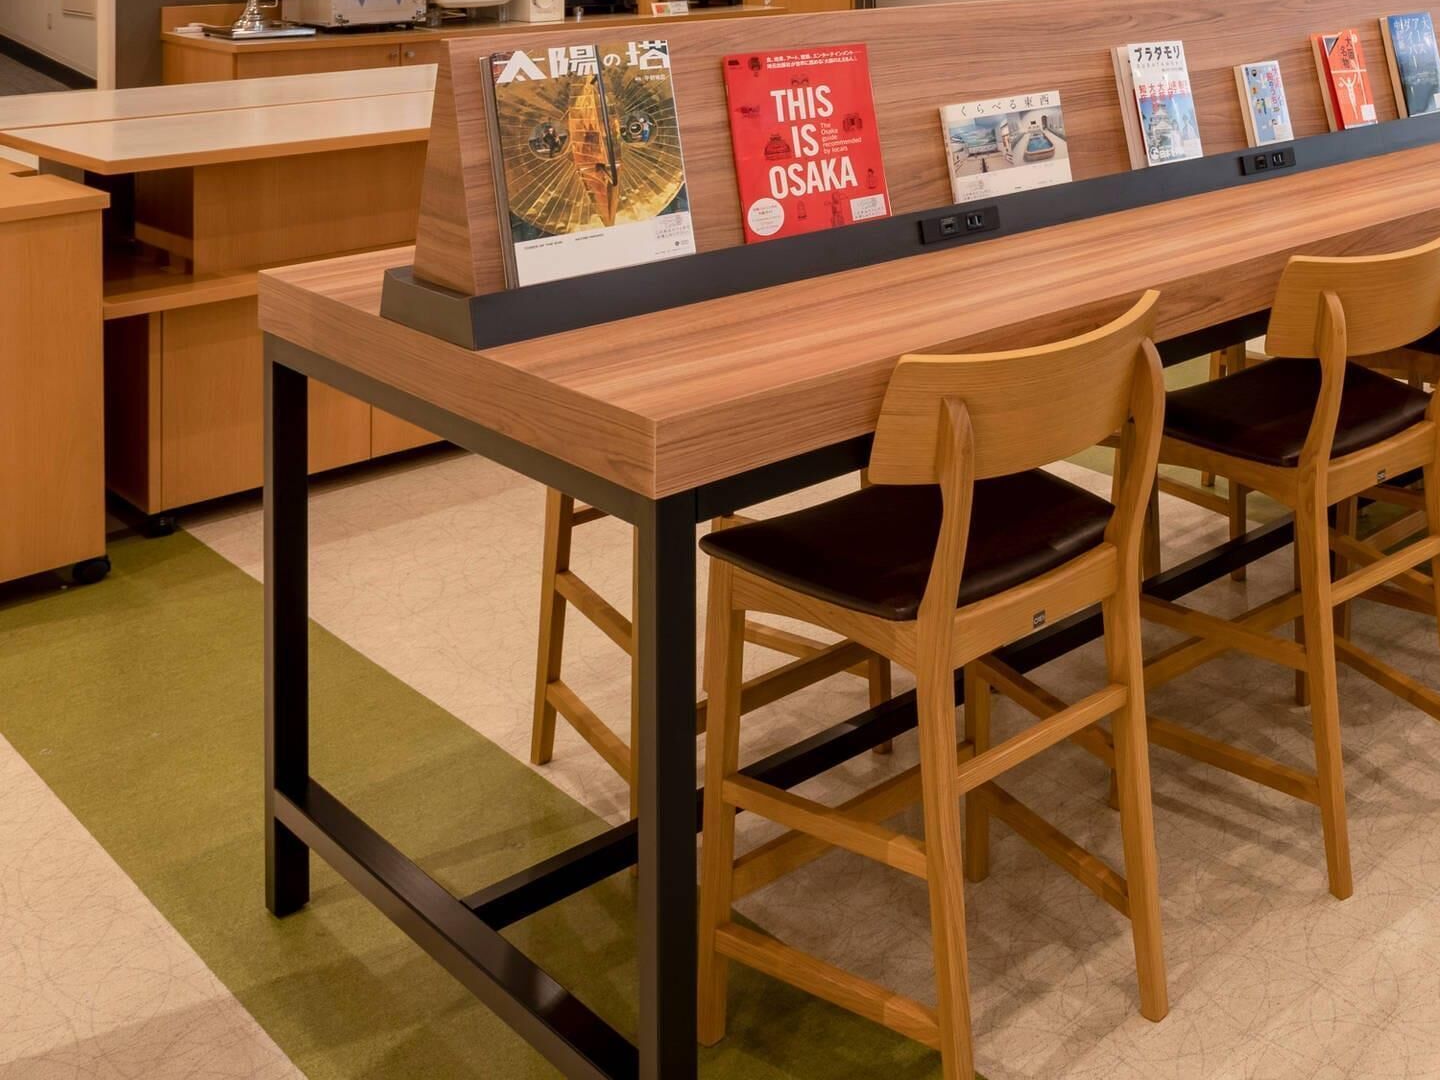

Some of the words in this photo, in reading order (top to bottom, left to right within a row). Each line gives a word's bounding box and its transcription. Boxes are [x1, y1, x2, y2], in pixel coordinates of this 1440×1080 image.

[493, 40, 671, 84] 太陽の塔
[1134, 45, 1180, 62] ブラタモリ
[770, 85, 834, 122] THIS
[960, 94, 1049, 117] くらべる東西
[791, 124, 820, 158] IS
[823, 137, 862, 147] recommended
[769, 156, 859, 199] OSAKA
